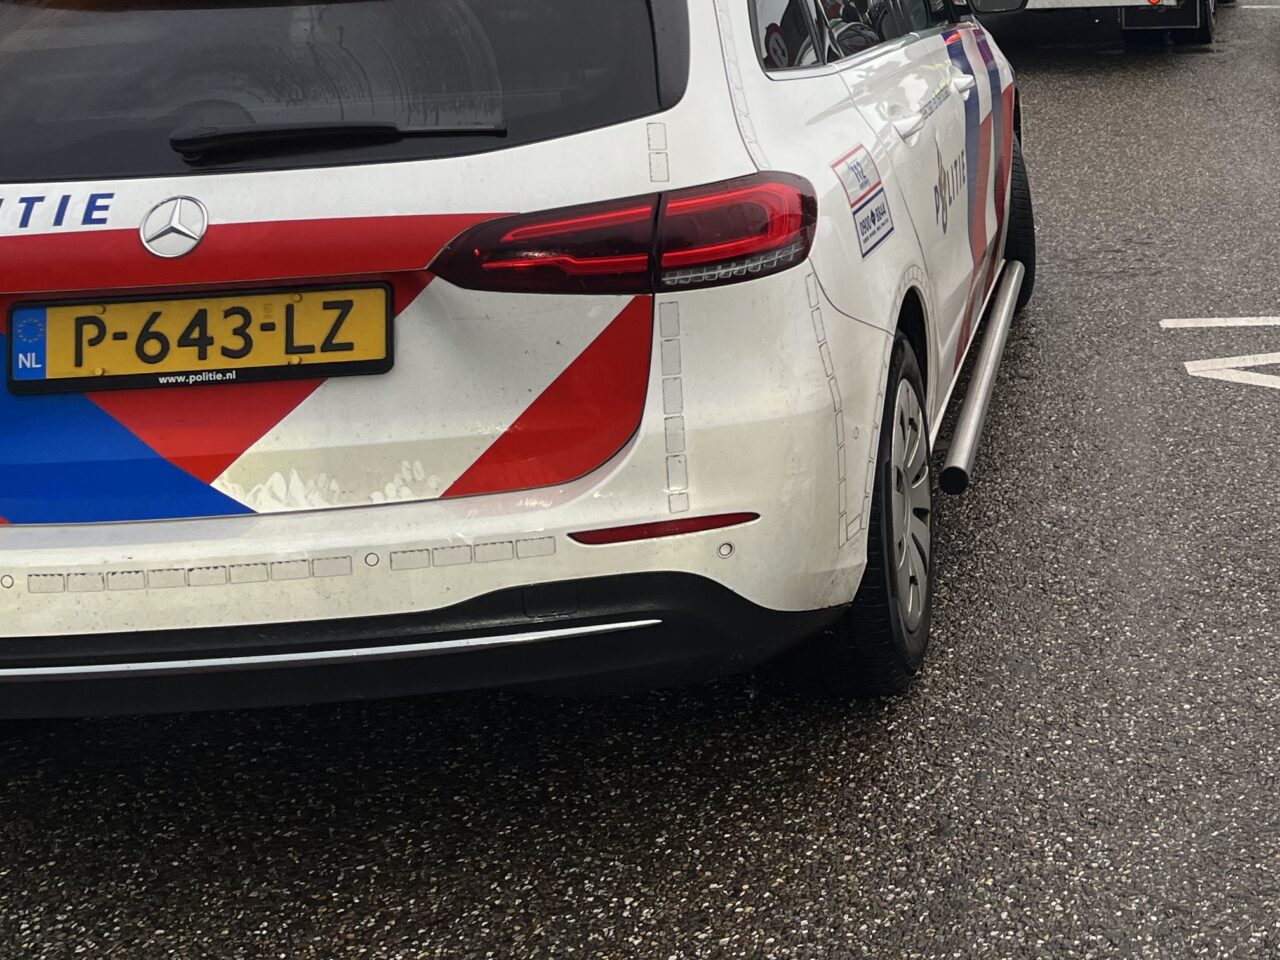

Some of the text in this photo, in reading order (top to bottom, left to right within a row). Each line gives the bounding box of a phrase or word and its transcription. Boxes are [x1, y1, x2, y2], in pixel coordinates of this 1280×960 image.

[0, 192, 116, 229] TIE
[74, 299, 355, 368] P-643-LZ
[18, 352, 42, 369] NL
[158, 370, 236, 384] www.politie.nl
